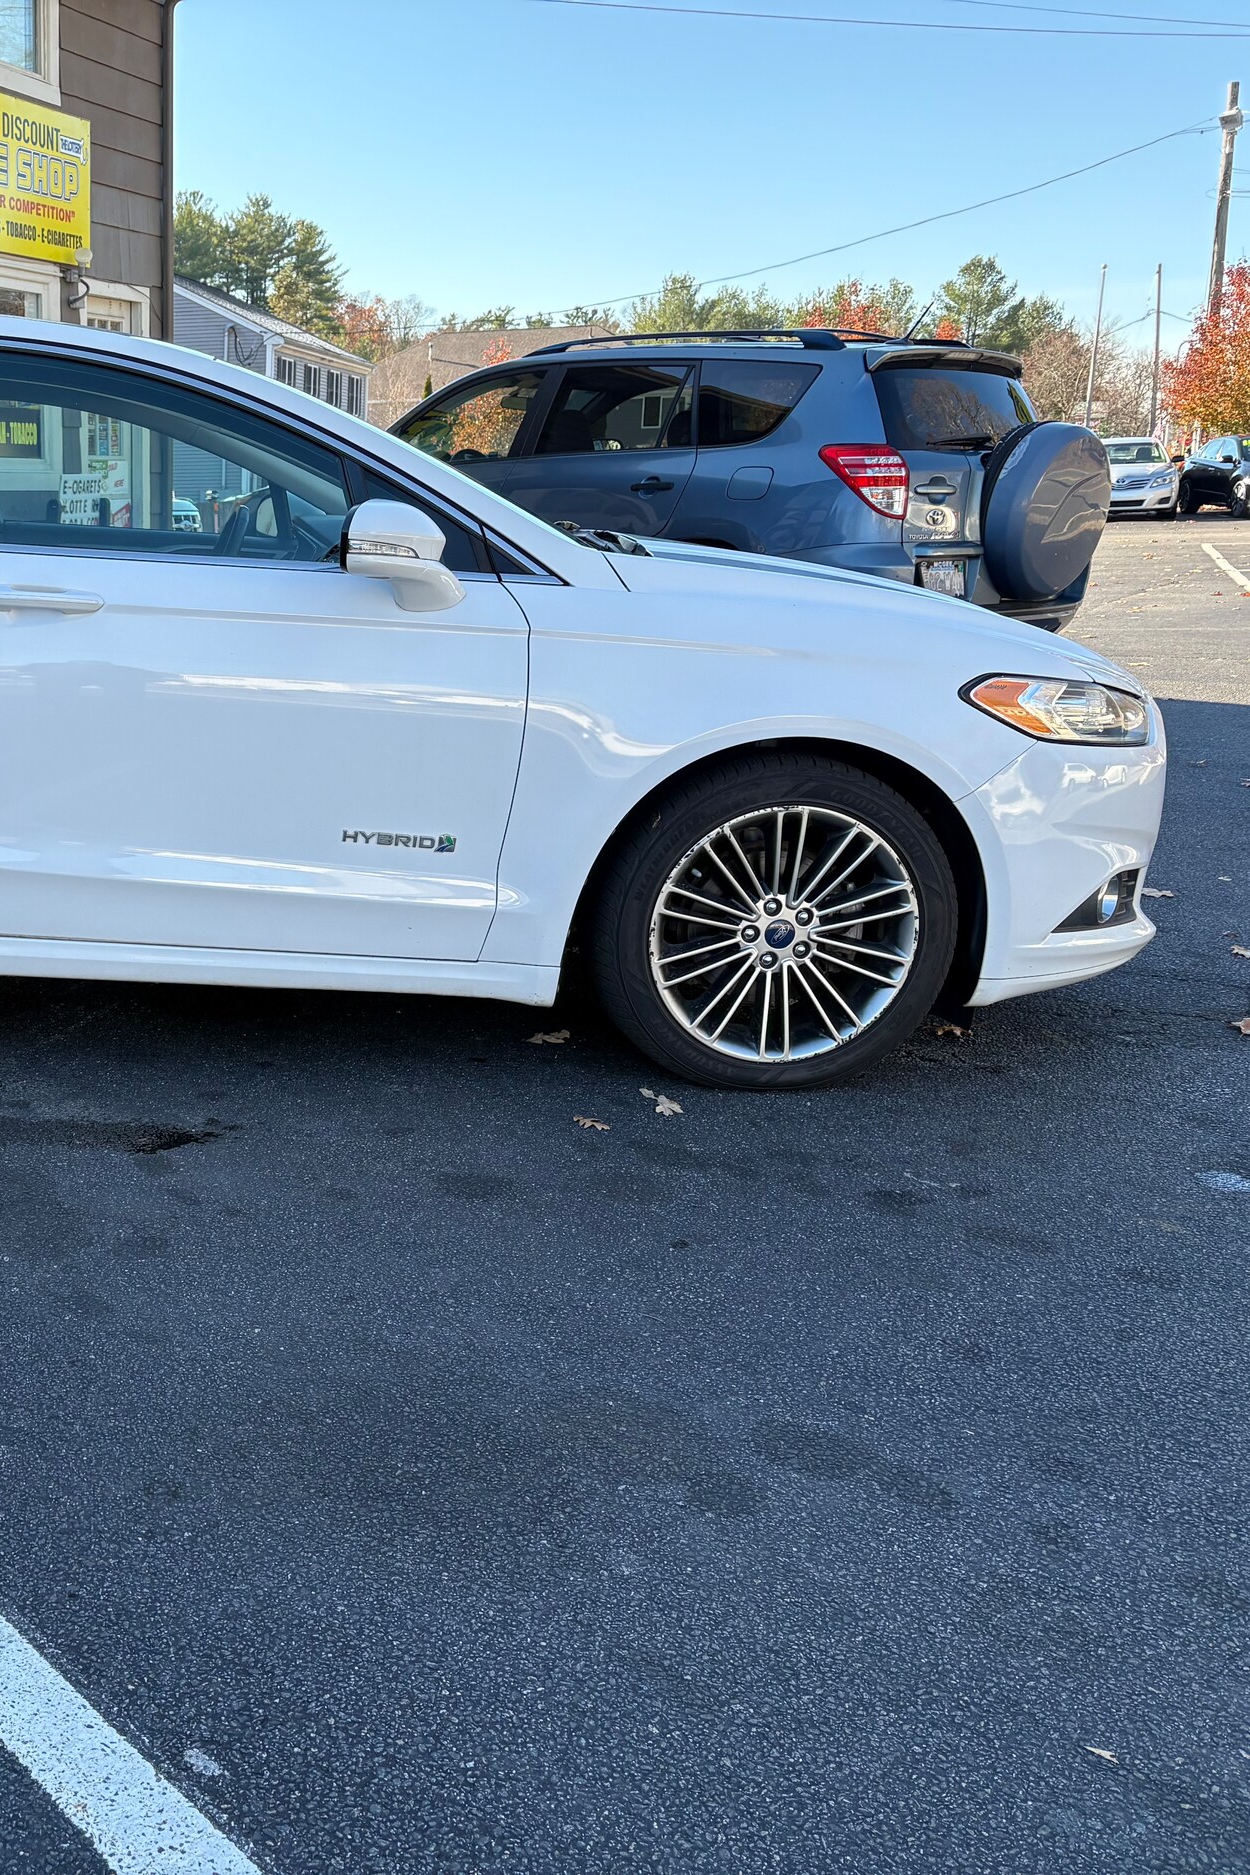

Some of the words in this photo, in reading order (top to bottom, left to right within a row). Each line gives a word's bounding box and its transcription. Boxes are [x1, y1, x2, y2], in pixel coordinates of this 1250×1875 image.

[2, 112, 61, 153] DISCOUNT
[16, 145, 80, 204] SHOP
[5, 220, 37, 242] TOBACCO
[41, 227, 83, 249] E-CIGARETTES
[9, 421, 38, 445] TOBACCO
[342, 829, 436, 850] HYBRID
